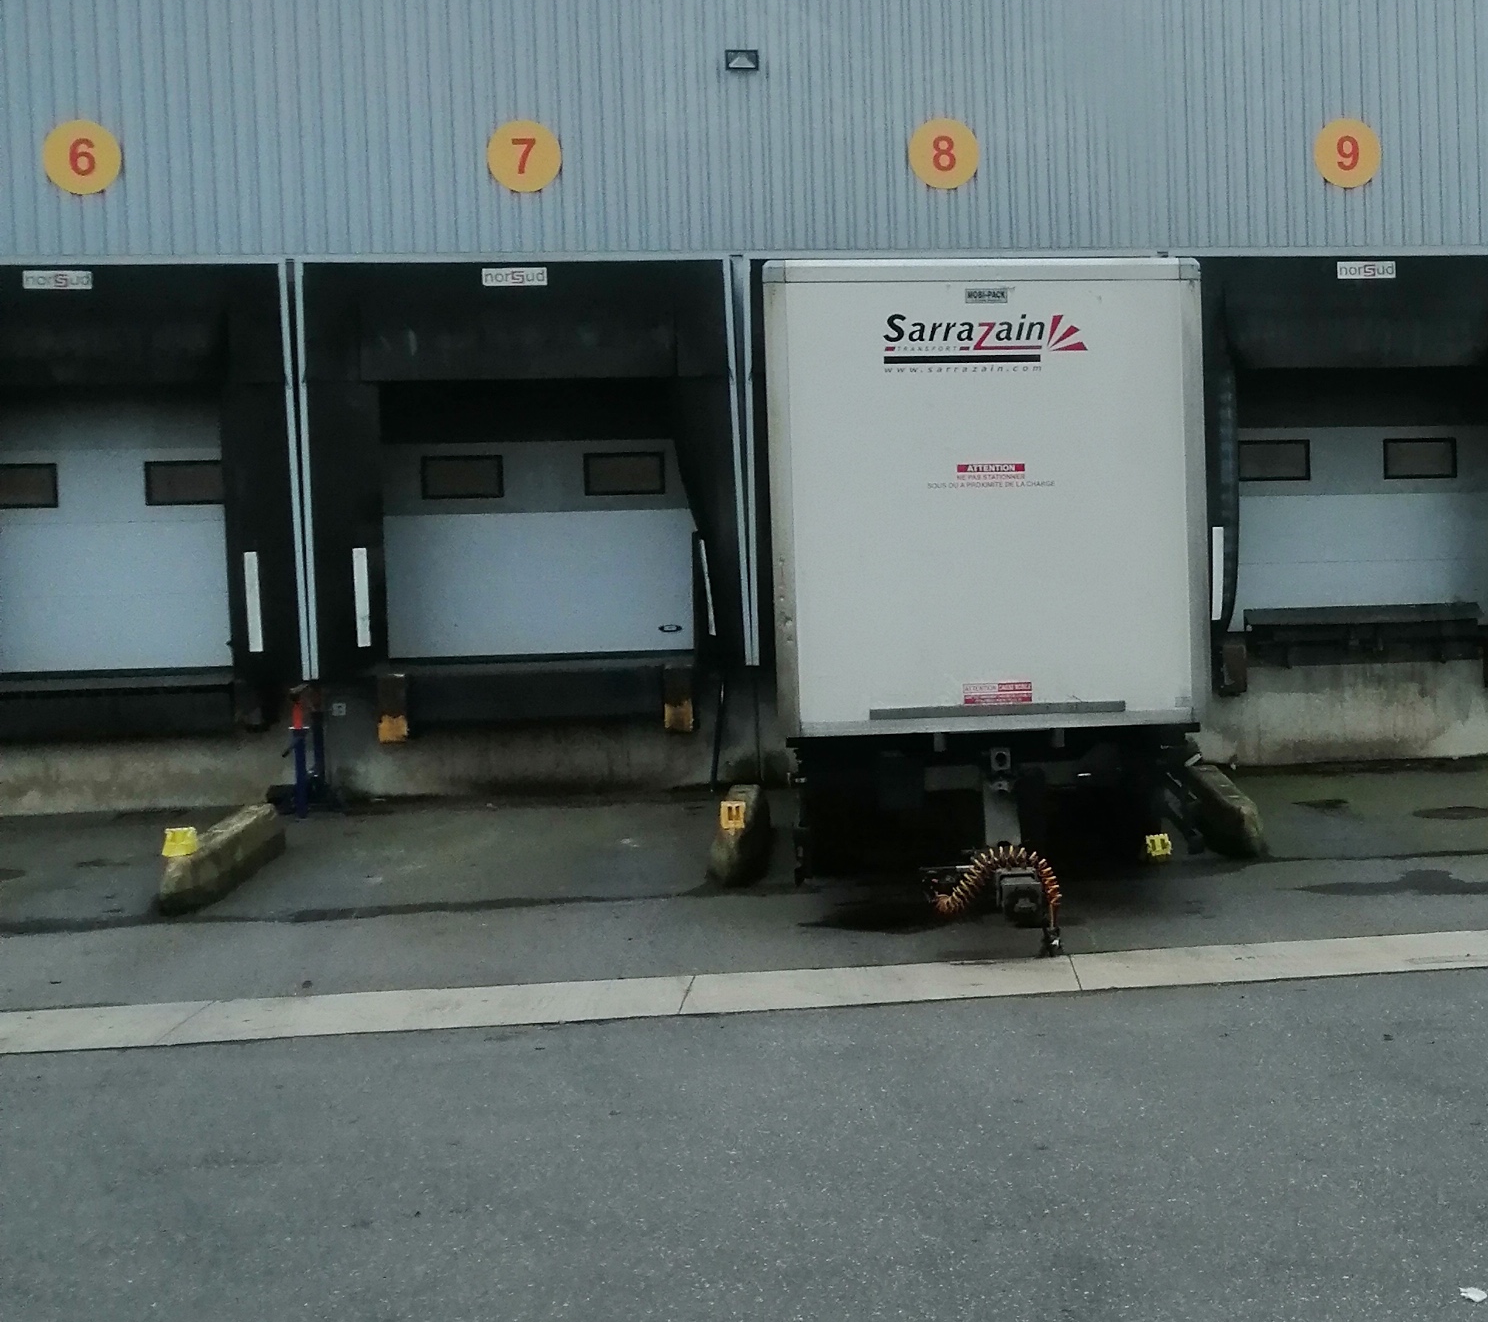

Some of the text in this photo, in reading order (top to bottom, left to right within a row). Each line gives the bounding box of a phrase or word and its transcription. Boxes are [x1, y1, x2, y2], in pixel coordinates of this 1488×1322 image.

[68, 137, 96, 177] 6
[511, 138, 537, 175] 7
[932, 135, 957, 172] 8
[1336, 135, 1360, 171] 9
[967, 290, 1006, 299] MOBI-PACK
[884, 365, 1042, 374] www.sarrazain.com
[966, 464, 1016, 472] ATTENTION
